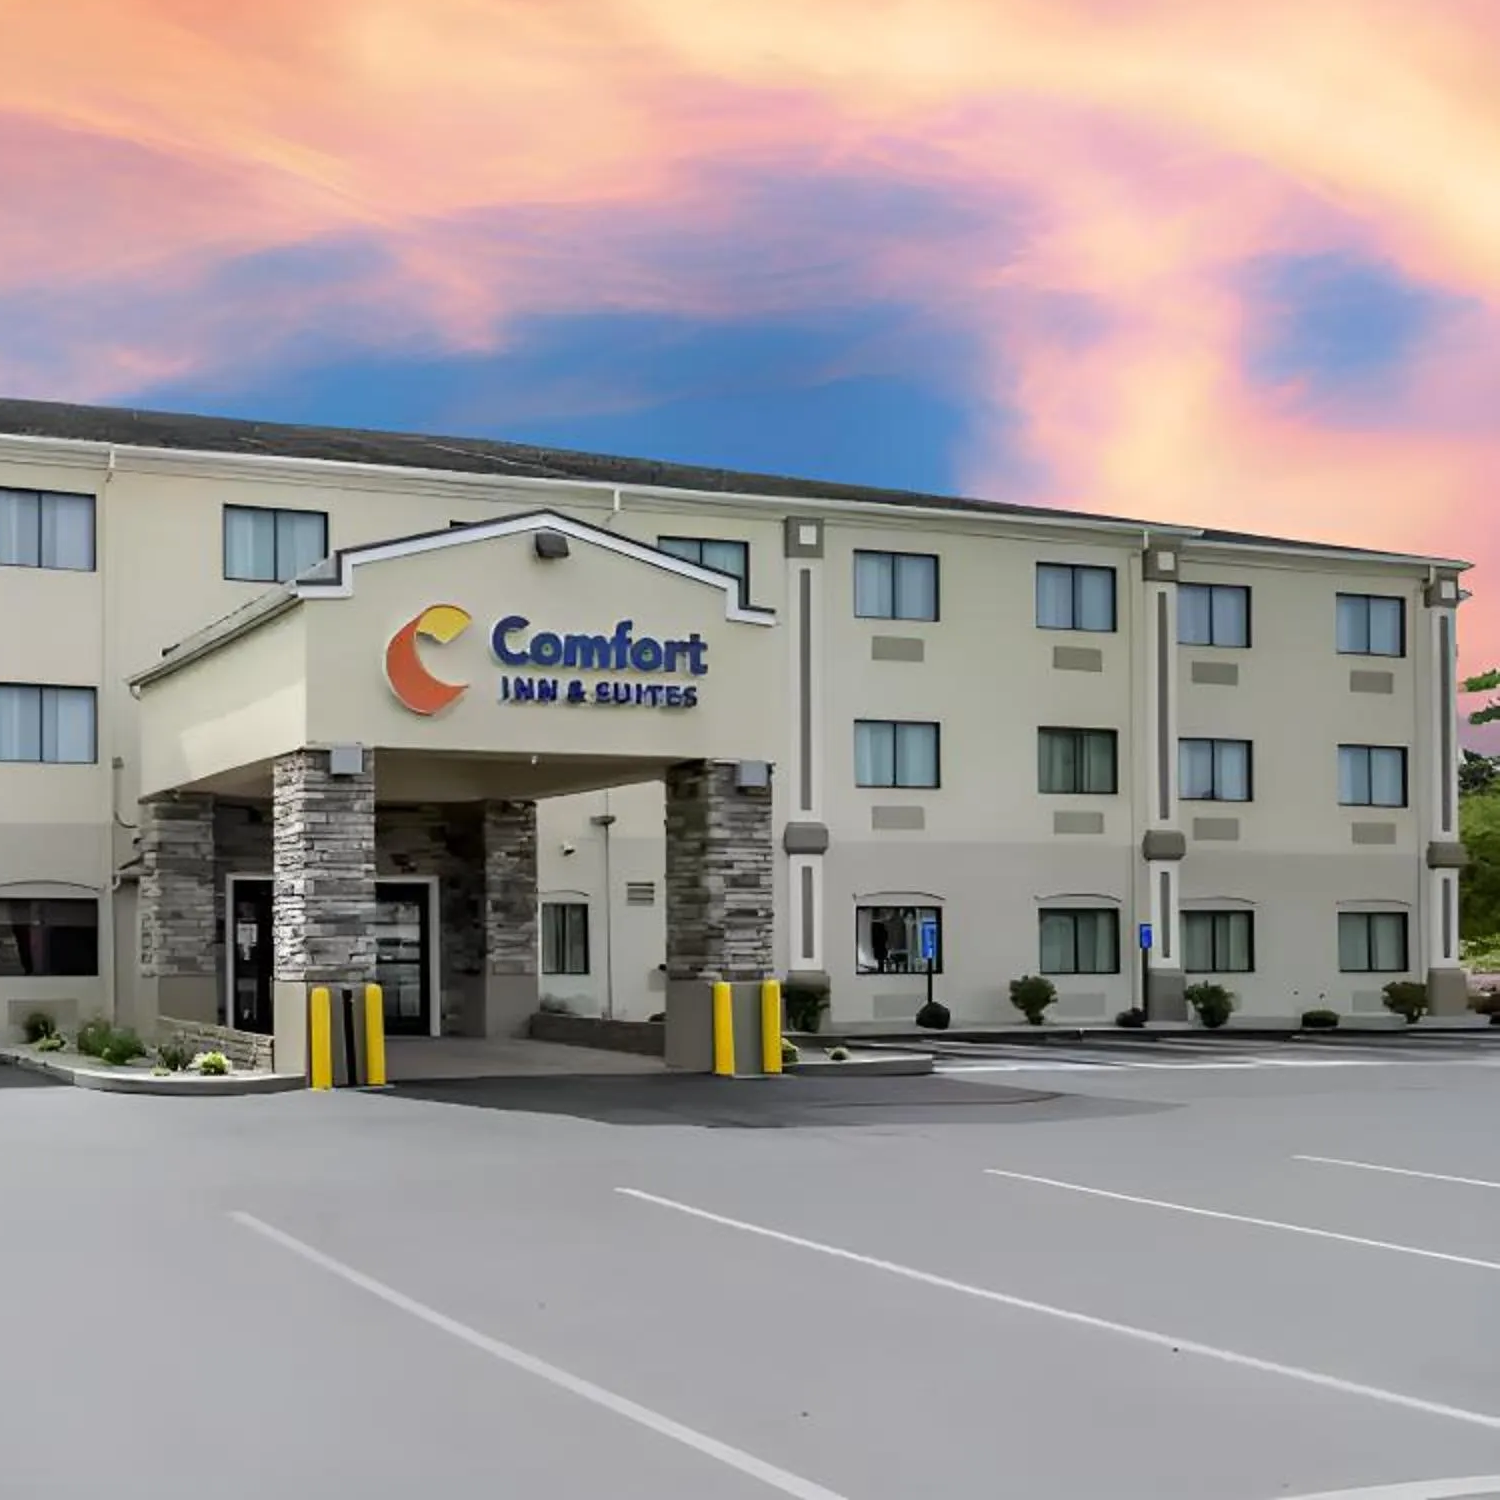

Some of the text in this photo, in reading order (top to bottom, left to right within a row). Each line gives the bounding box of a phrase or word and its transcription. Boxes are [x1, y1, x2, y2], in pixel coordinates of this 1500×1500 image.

[491, 615, 708, 675] Comfort
[501, 675, 699, 709] INN & SUITES
